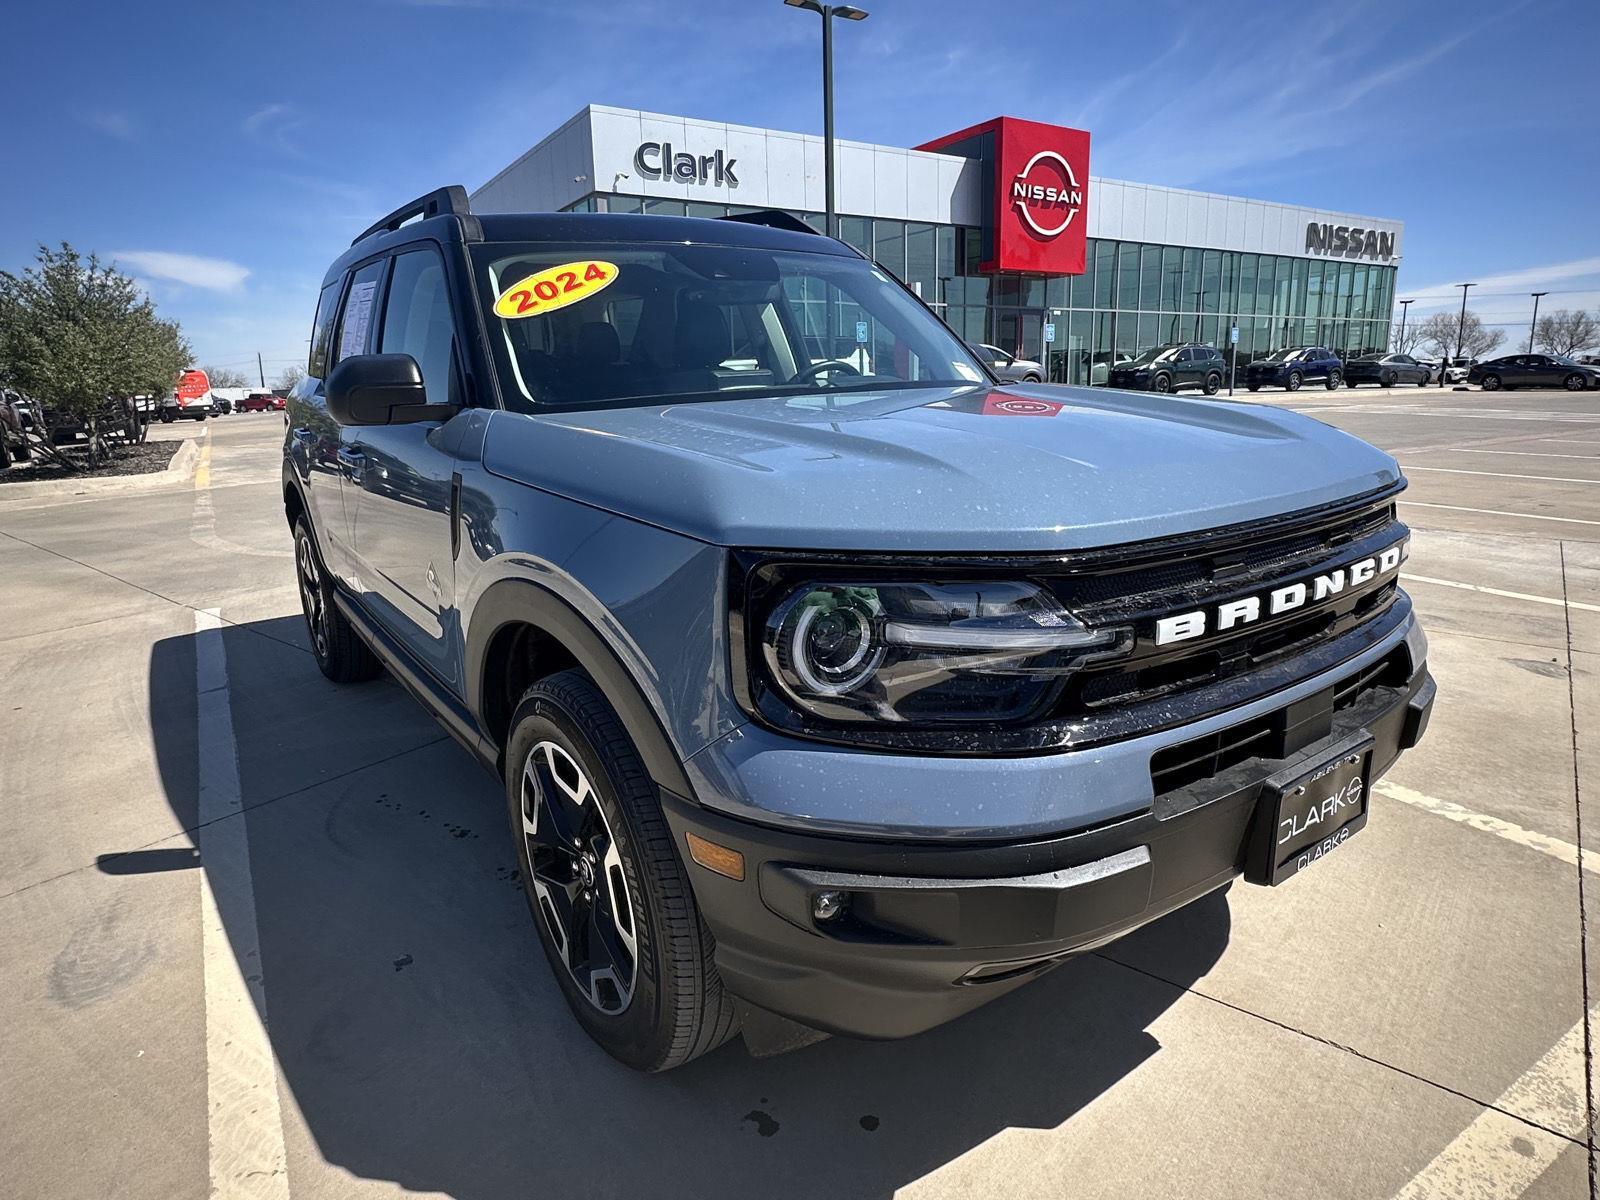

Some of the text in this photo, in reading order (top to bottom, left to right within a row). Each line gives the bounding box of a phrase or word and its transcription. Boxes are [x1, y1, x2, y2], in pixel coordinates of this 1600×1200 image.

[634, 142, 739, 188] Clark
[1013, 182, 1082, 205] NISSAN
[1306, 222, 1395, 261] NISSAN
[509, 263, 607, 314] 2024
[1156, 546, 1400, 646] BRONCO
[1297, 832, 1341, 872] CLARK
[623, 856, 654, 981] MICHELIN
